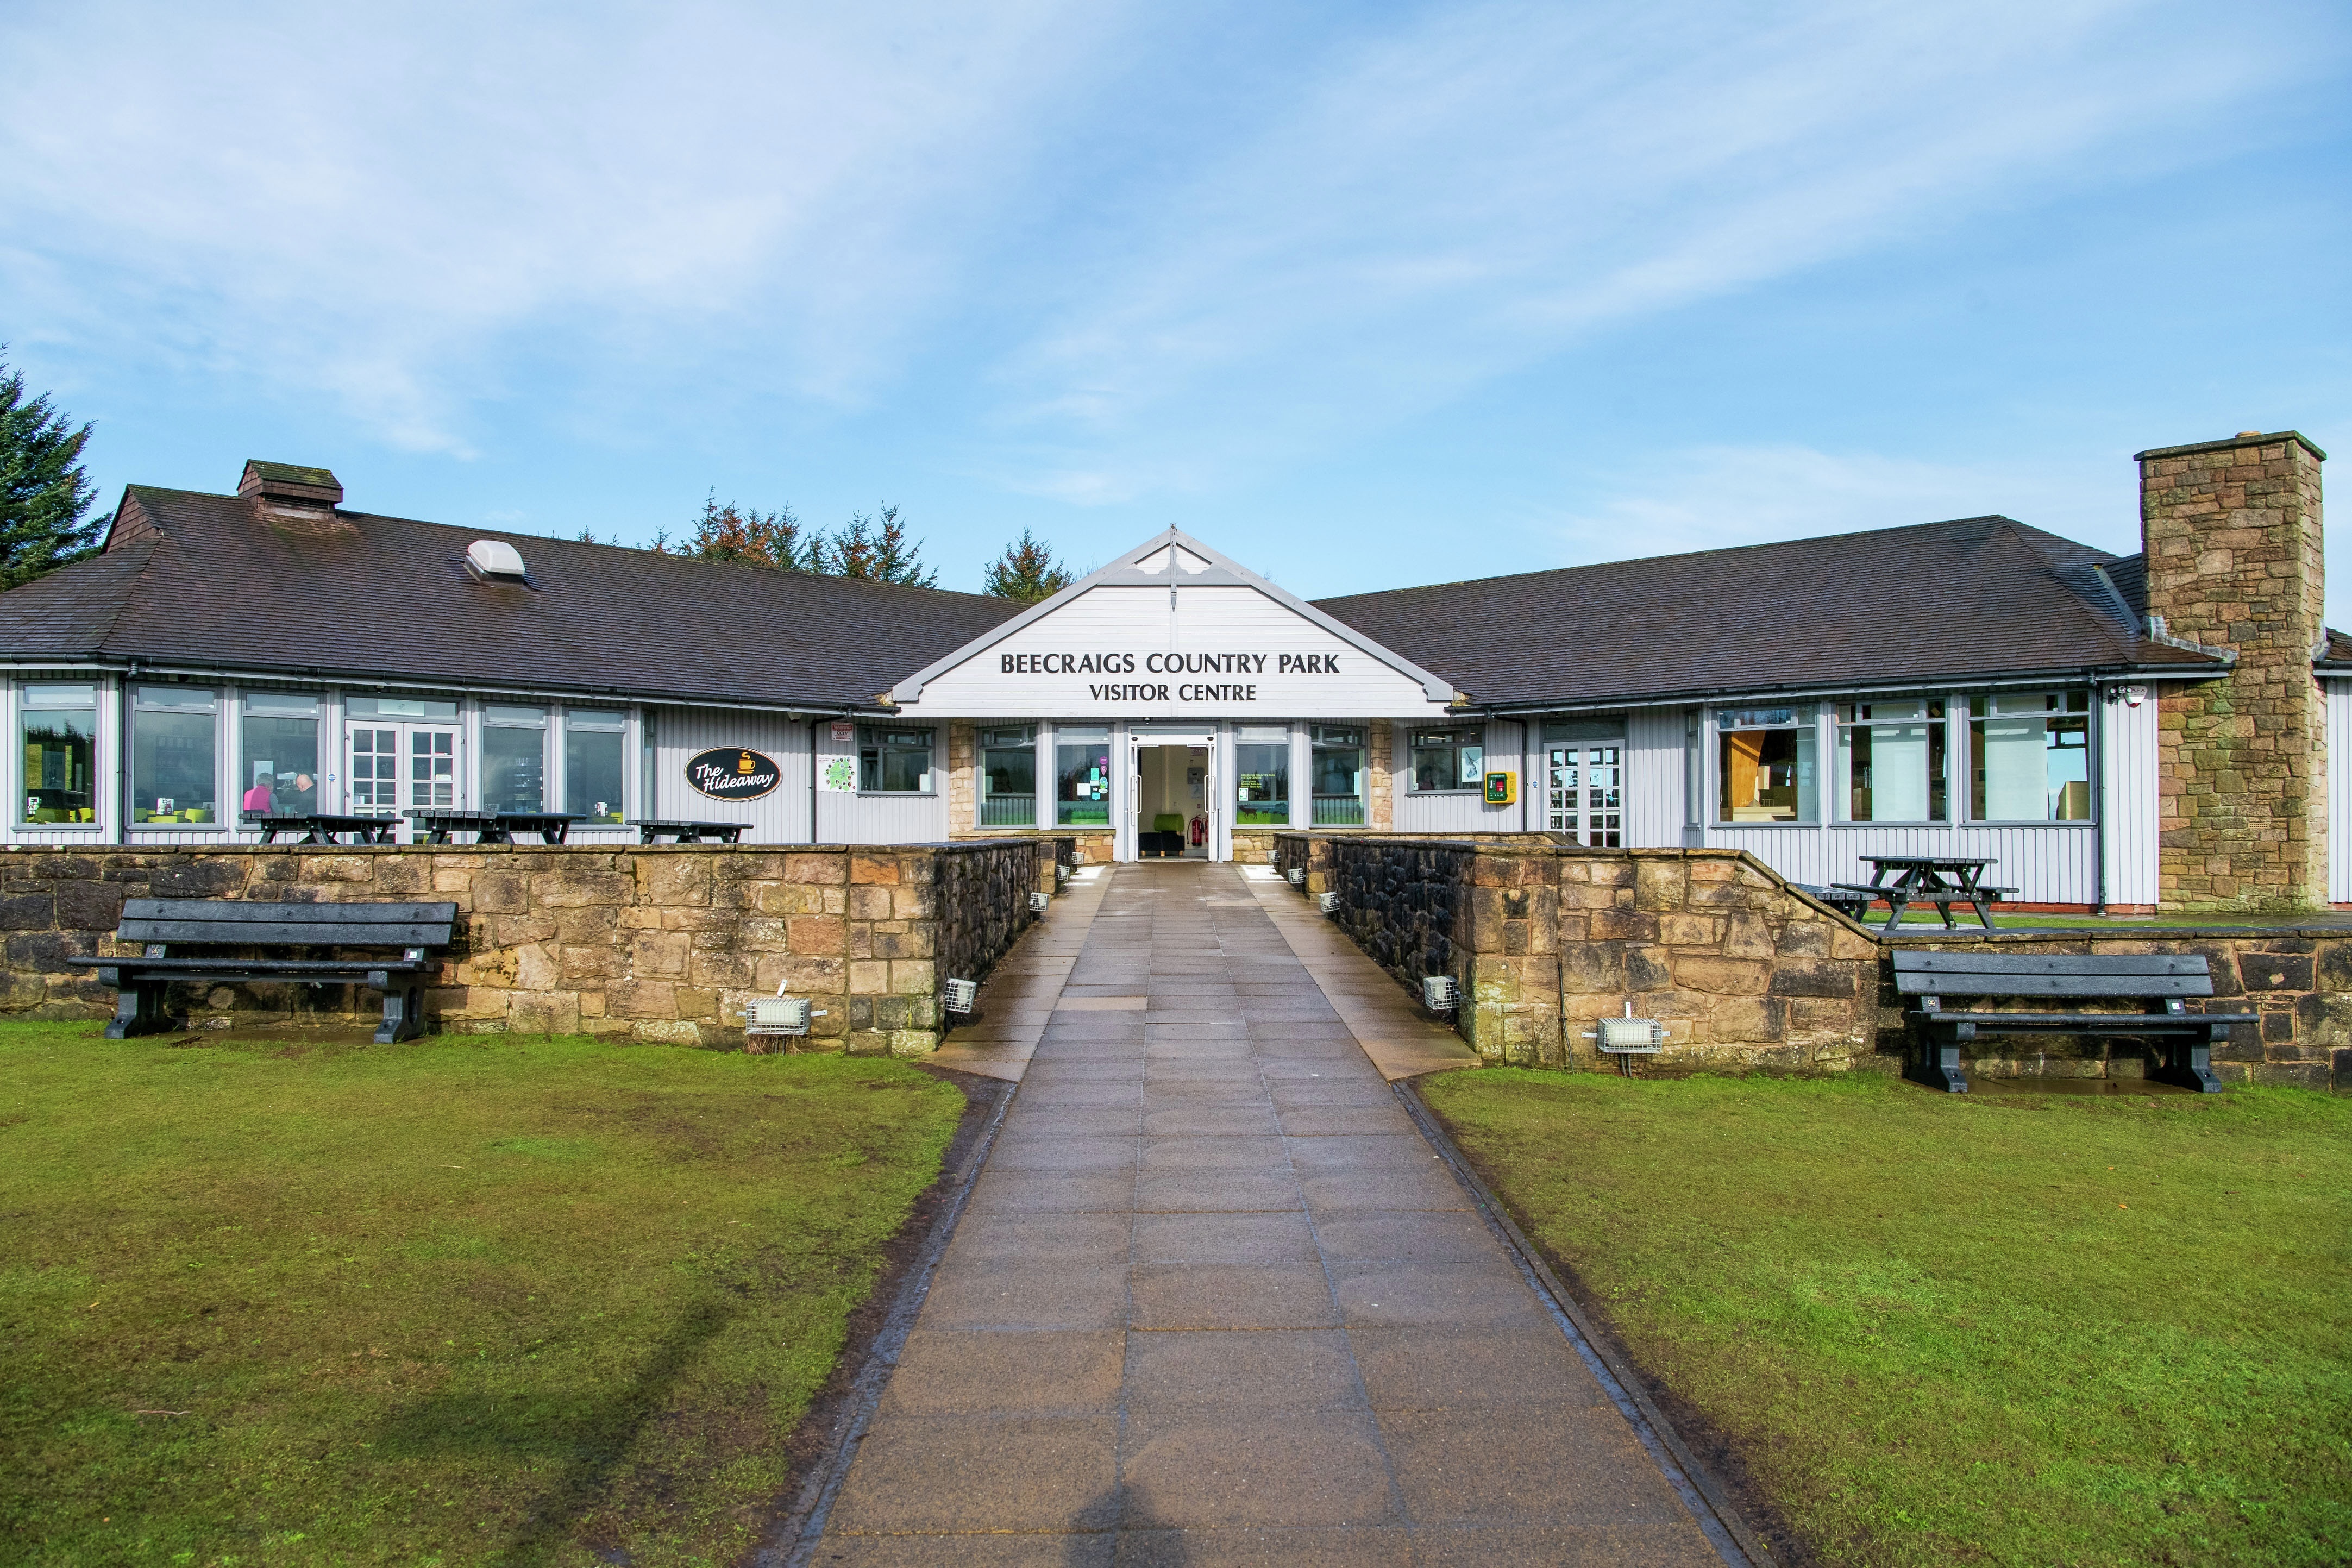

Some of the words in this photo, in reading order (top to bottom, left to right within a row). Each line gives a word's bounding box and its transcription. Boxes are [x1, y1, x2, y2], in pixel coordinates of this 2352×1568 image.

[1001, 653, 1135, 673] BEECRAIGS
[1146, 653, 1268, 673] COUNTRY
[1278, 654, 1340, 673] PARK
[1089, 684, 1170, 701] VISITOR
[1178, 684, 1256, 701] CENTRE
[695, 763, 724, 779] The
[703, 773, 774, 792] Hideaway
